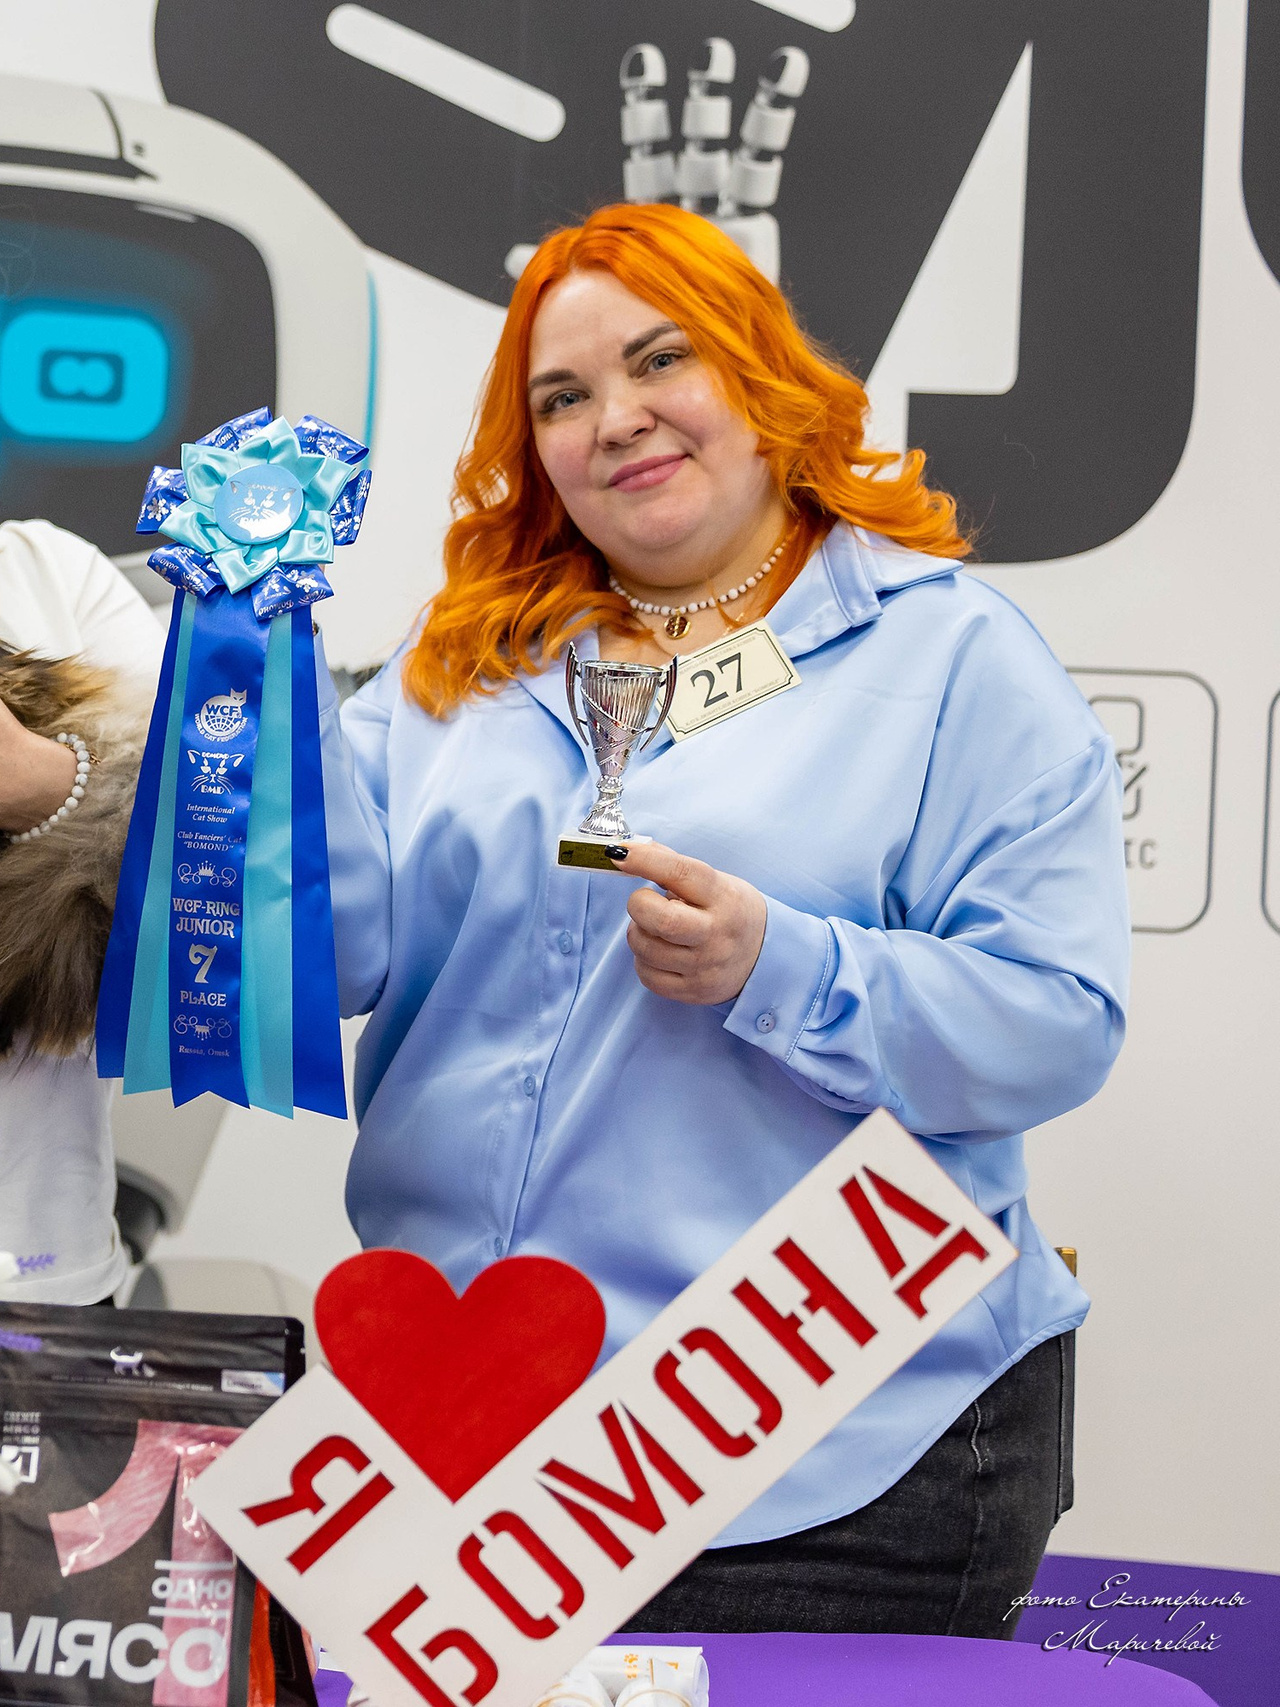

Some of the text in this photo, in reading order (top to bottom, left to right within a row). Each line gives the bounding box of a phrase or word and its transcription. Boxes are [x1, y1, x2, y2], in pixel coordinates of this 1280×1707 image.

[690, 652, 742, 708] 27
[205, 704, 239, 716] WCF
[186, 803, 236, 814] International
[192, 813, 228, 823] Cat Show
[177, 831, 193, 839] Club
[172, 898, 240, 917] WCF-RING
[175, 917, 235, 938] JUNIOR
[188, 943, 218, 983] 7
[180, 990, 227, 1007] PLACE
[208, 1048, 230, 1057] Omsk
[363, 1163, 992, 1707] БОМОНД
[241, 1433, 396, 1576] Я
